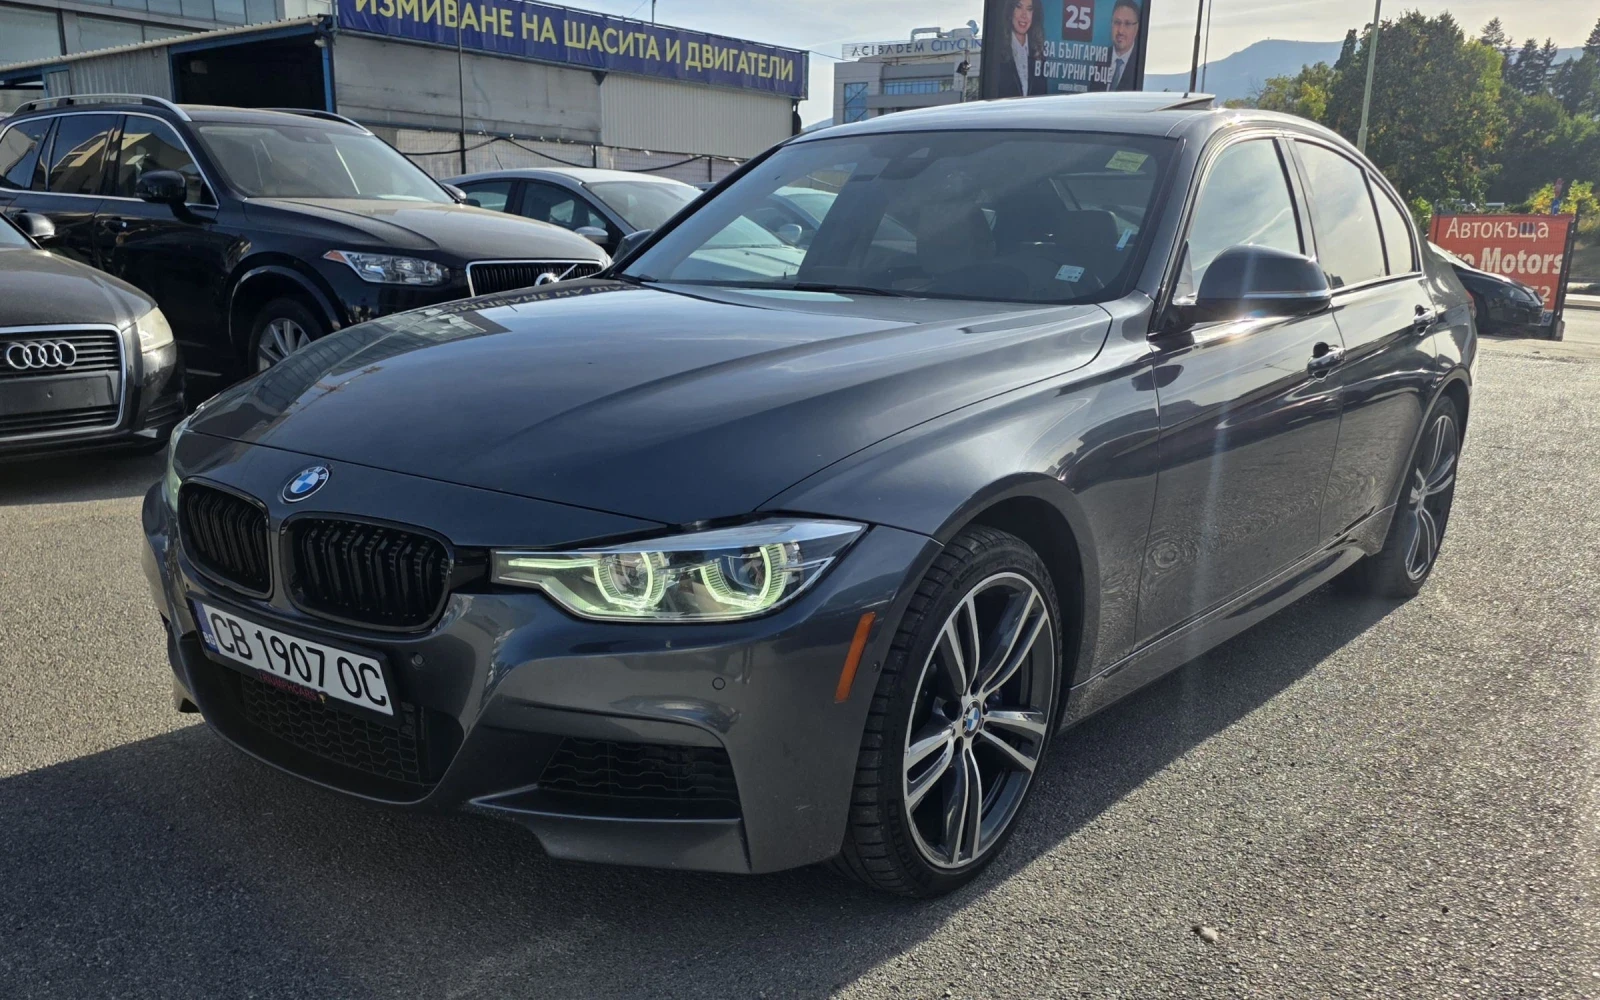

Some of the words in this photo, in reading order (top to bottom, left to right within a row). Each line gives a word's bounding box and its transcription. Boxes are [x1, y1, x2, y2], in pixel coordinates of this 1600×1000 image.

[1065, 4, 1092, 31] 25
[521, 12, 557, 45] НА
[564, 19, 661, 61] ШАСИТА
[666, 37, 681, 64] И
[685, 42, 793, 82] ДВИГАТЕЛИ
[852, 42, 925, 57] ACIBADEM
[1043, 40, 1056, 58] ЗА
[1058, 42, 1109, 63] БЪЛГАРИЯ
[1034, 60, 1042, 77] В
[1043, 61, 1087, 80] СИГУРНИ
[1088, 65, 1113, 84] РЪЦЕ
[1480, 247, 1564, 275] Motors
[202, 631, 216, 646] BG
[210, 612, 253, 661] CB
[254, 629, 326, 688] 1907
[336, 656, 387, 707] OC
